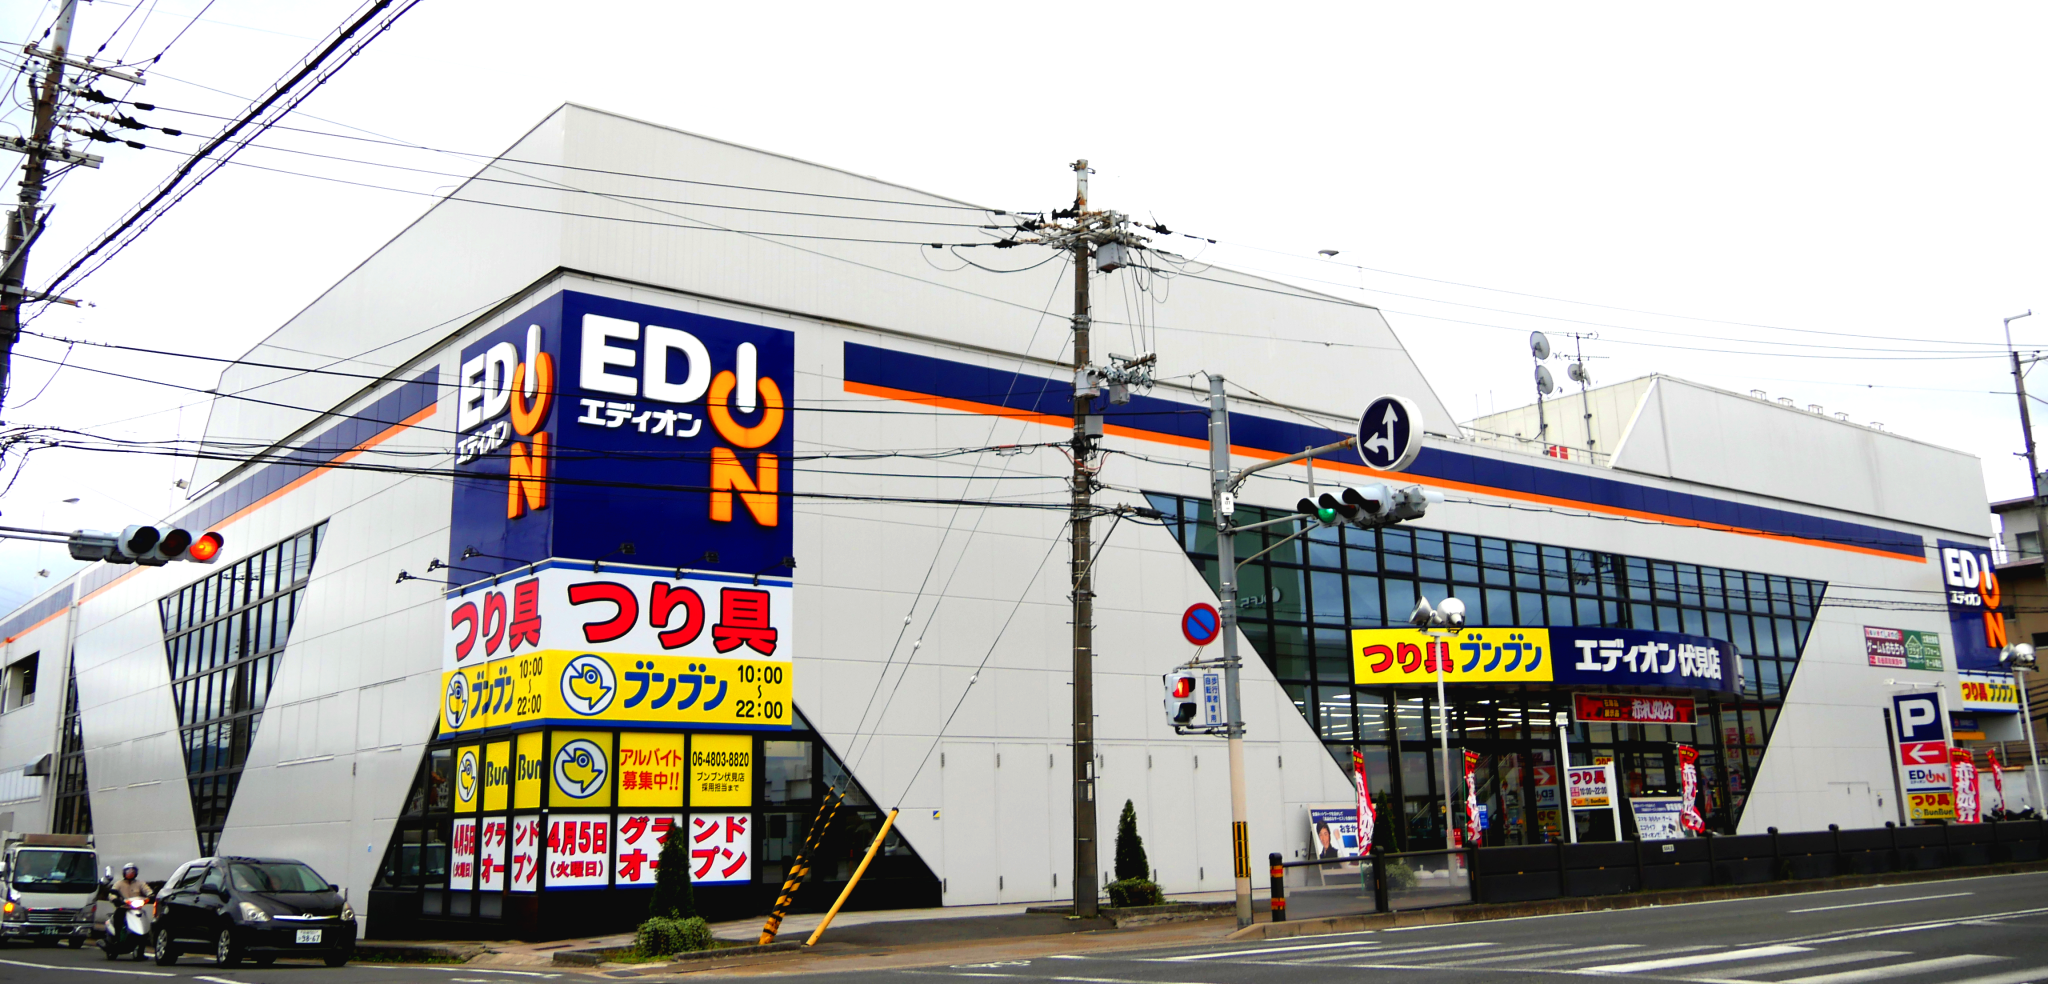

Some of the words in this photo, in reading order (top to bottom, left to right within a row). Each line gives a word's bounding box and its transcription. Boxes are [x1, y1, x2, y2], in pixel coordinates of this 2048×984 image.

[459, 324, 552, 519] EDION
[578, 398, 702, 437] エディオン
[580, 313, 784, 527] EDION
[456, 421, 512, 464] エディオン
[1943, 548, 2007, 648] EDION
[451, 577, 541, 662] つり具
[568, 581, 778, 656] つり具
[519, 656, 543, 679] 10:00
[1362, 642, 1454, 674] つり具
[1460, 633, 1542, 673] ブンブン
[1575, 638, 1722, 680] エディオン伏見店
[624, 660, 728, 711] ブンブン
[738, 665, 783, 685] 10:00
[1962, 683, 1987, 700] つり具
[1989, 679, 2013, 701] ブンブン
[471, 665, 515, 719] ブンブン
[516, 693, 542, 716] 22:00
[735, 701, 783, 719] 22:00
[1632, 699, 1675, 720] 赤札処分
[1899, 699, 1935, 737] P
[486, 761, 509, 787] Bun
[518, 754, 542, 781] Bun
[620, 748, 682, 767] アルバイト
[692, 751, 749, 767] 06-4803-8820
[622, 771, 680, 790] 募集中!!
[697, 772, 745, 782] ブンブン伏見店
[701, 783, 739, 792] 採用担当まで
[1570, 770, 1606, 785] つり具
[1909, 770, 1946, 783] EDION
[1912, 794, 1950, 806] つり具
[453, 824, 476, 857] 4月5日
[548, 821, 608, 856] 4月5日
